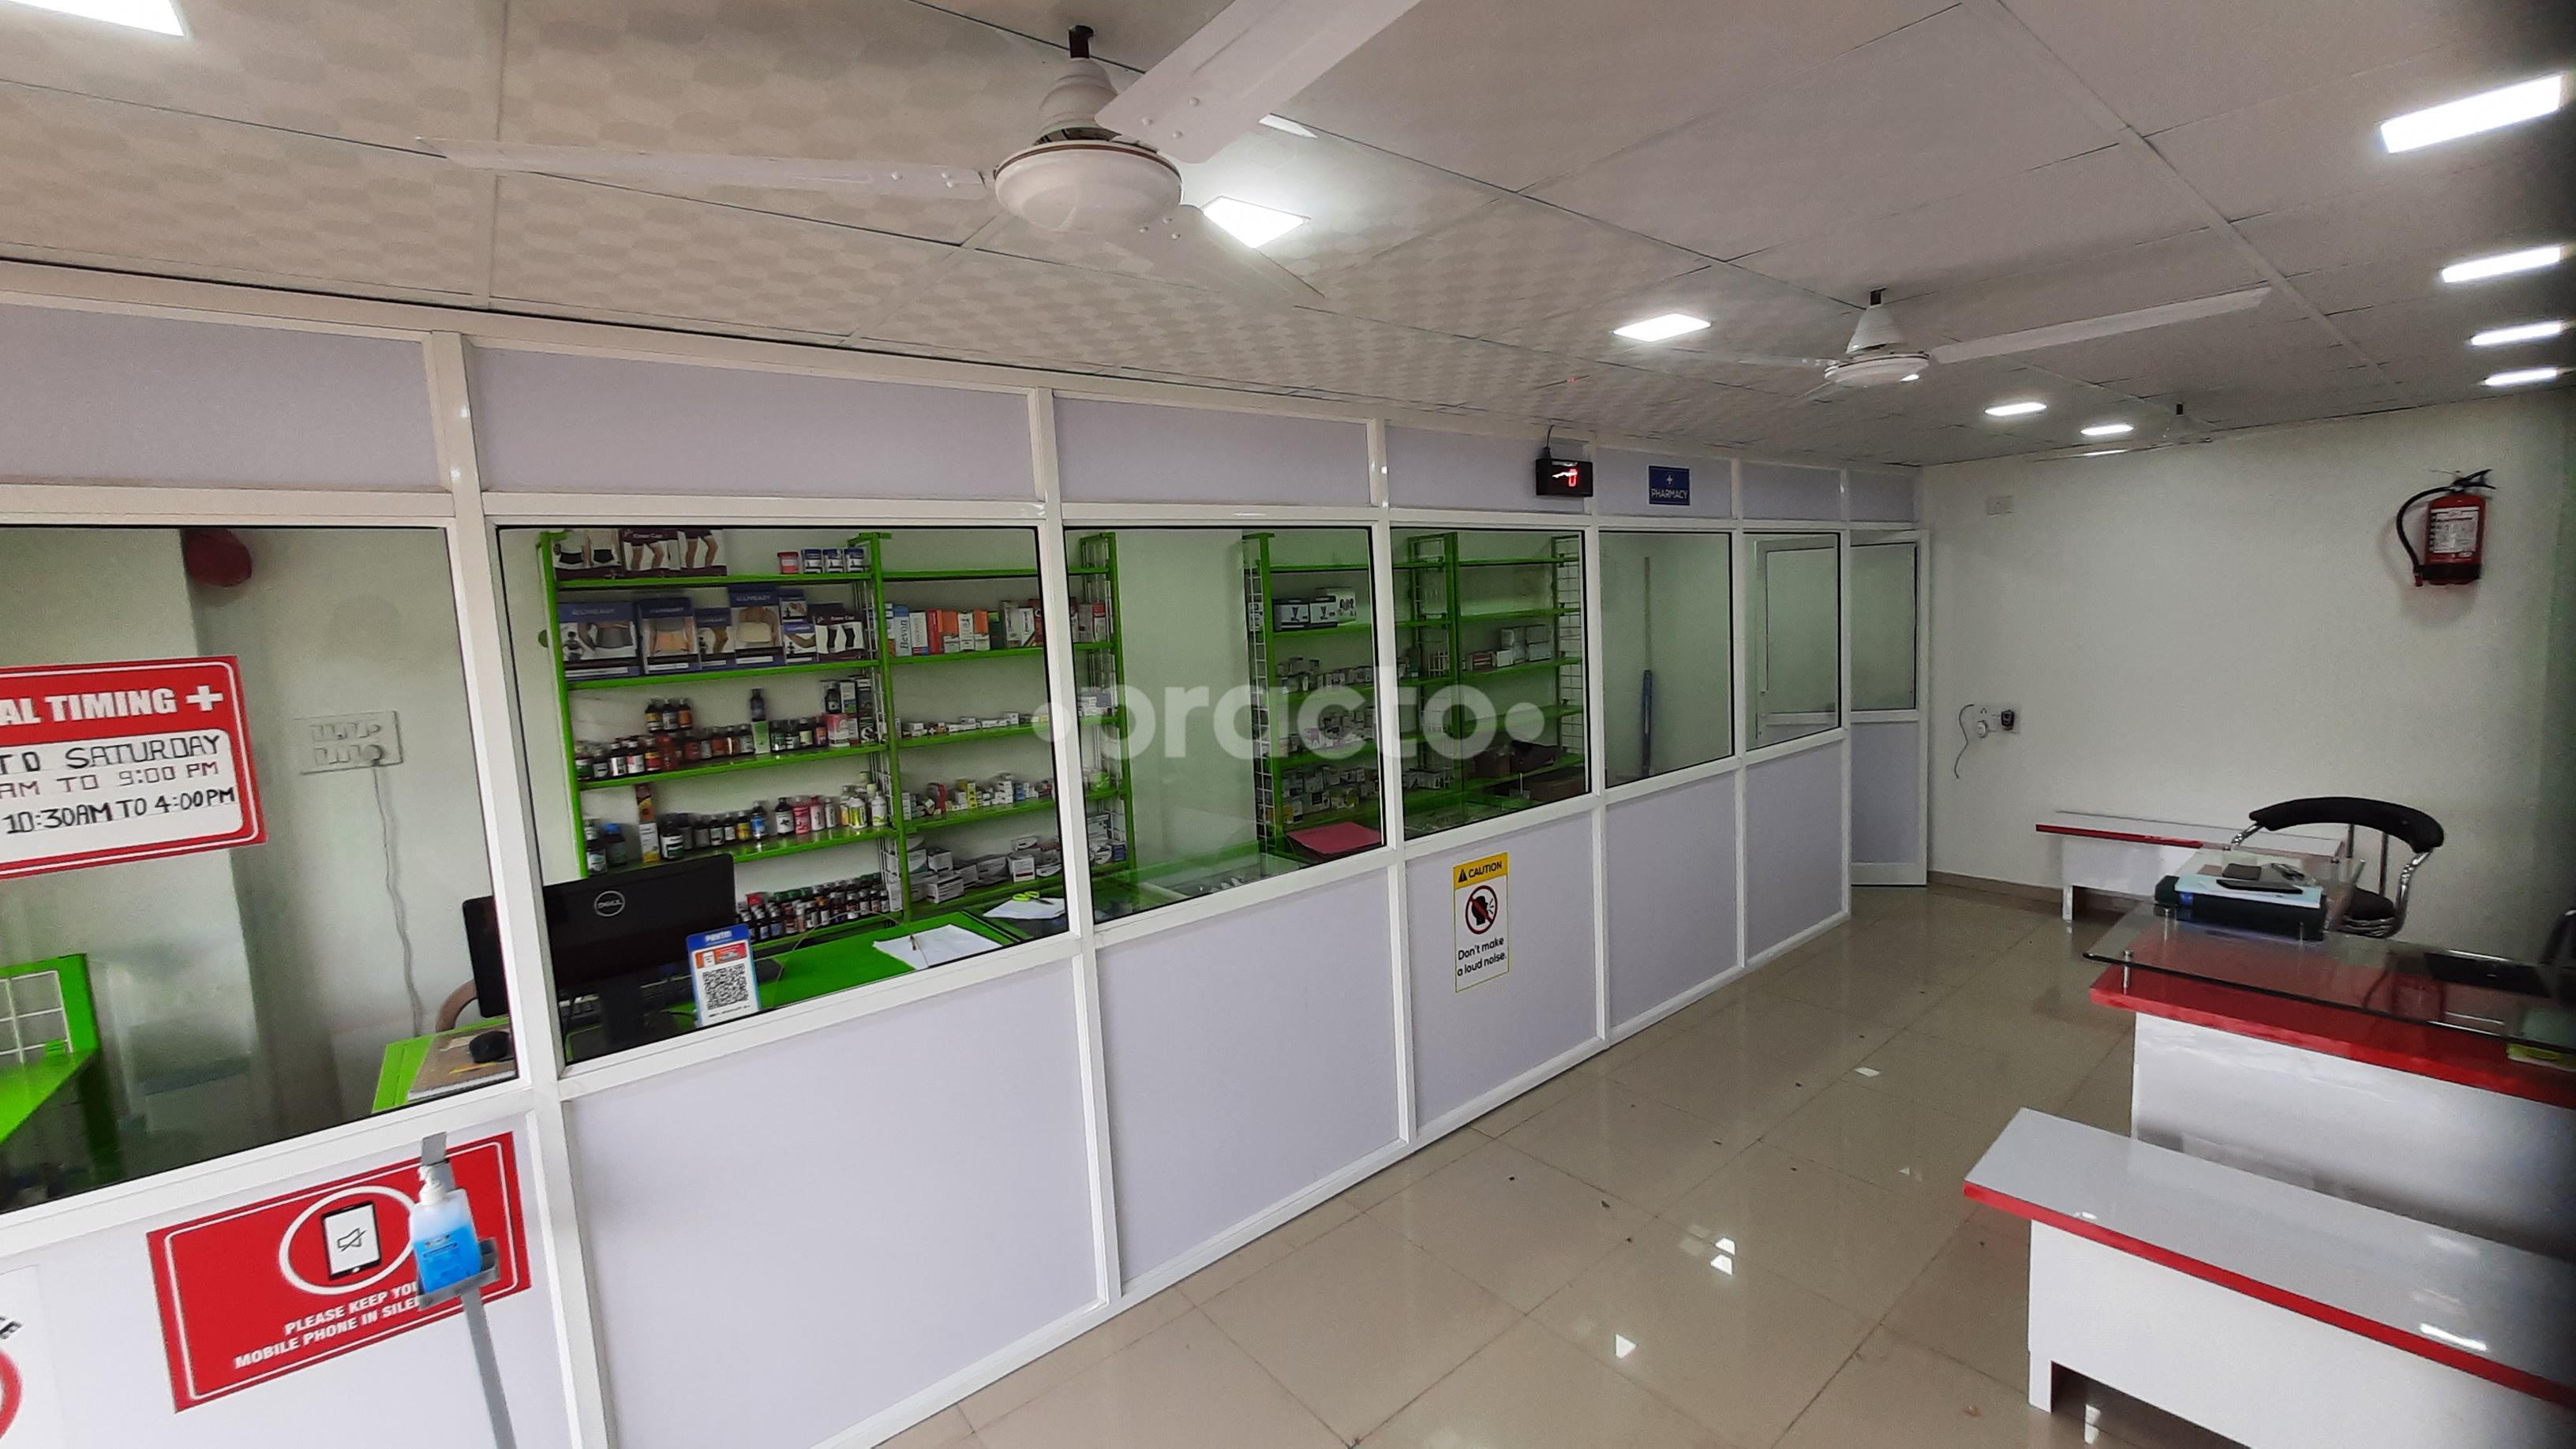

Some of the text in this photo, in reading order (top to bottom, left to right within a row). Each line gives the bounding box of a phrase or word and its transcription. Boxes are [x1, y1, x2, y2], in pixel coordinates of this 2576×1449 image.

[1651, 488, 1687, 499] PHARMACY
[44, 687, 178, 722] TIMING
[65, 735, 219, 769] SATURDAY
[56, 774, 99, 792] TO
[118, 766, 176, 787] 9:00
[186, 761, 219, 778] PM
[115, 797, 148, 818] TO
[1468, 861, 1503, 878] CAUTION
[597, 899, 622, 908] DELL
[1458, 937, 1504, 960] Don't make
[1457, 951, 1507, 977] a loud noise.
[284, 1305, 346, 1335] PLEASE
[349, 1290, 389, 1314] KEEP
[234, 1295, 421, 1370] MOBILE PHONE IN SILE
